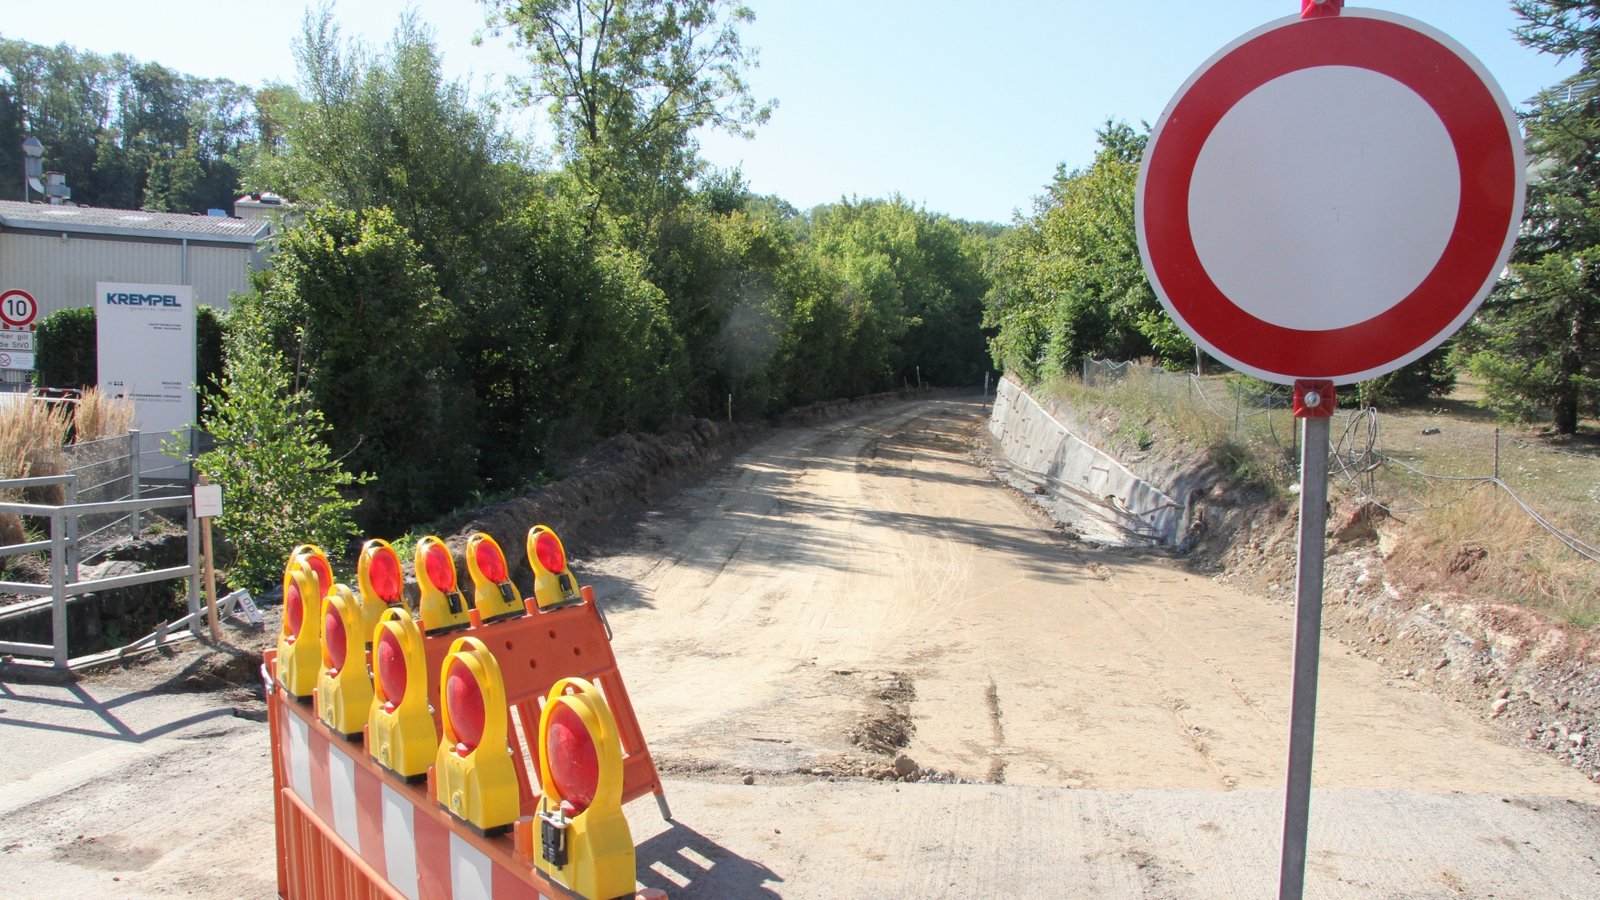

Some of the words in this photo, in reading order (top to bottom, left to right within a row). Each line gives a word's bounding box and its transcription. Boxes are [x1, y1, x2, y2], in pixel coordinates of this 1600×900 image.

[106, 293, 181, 307] KREMPEL
[7, 299, 27, 317] 10
[17, 333, 29, 341] gilt
